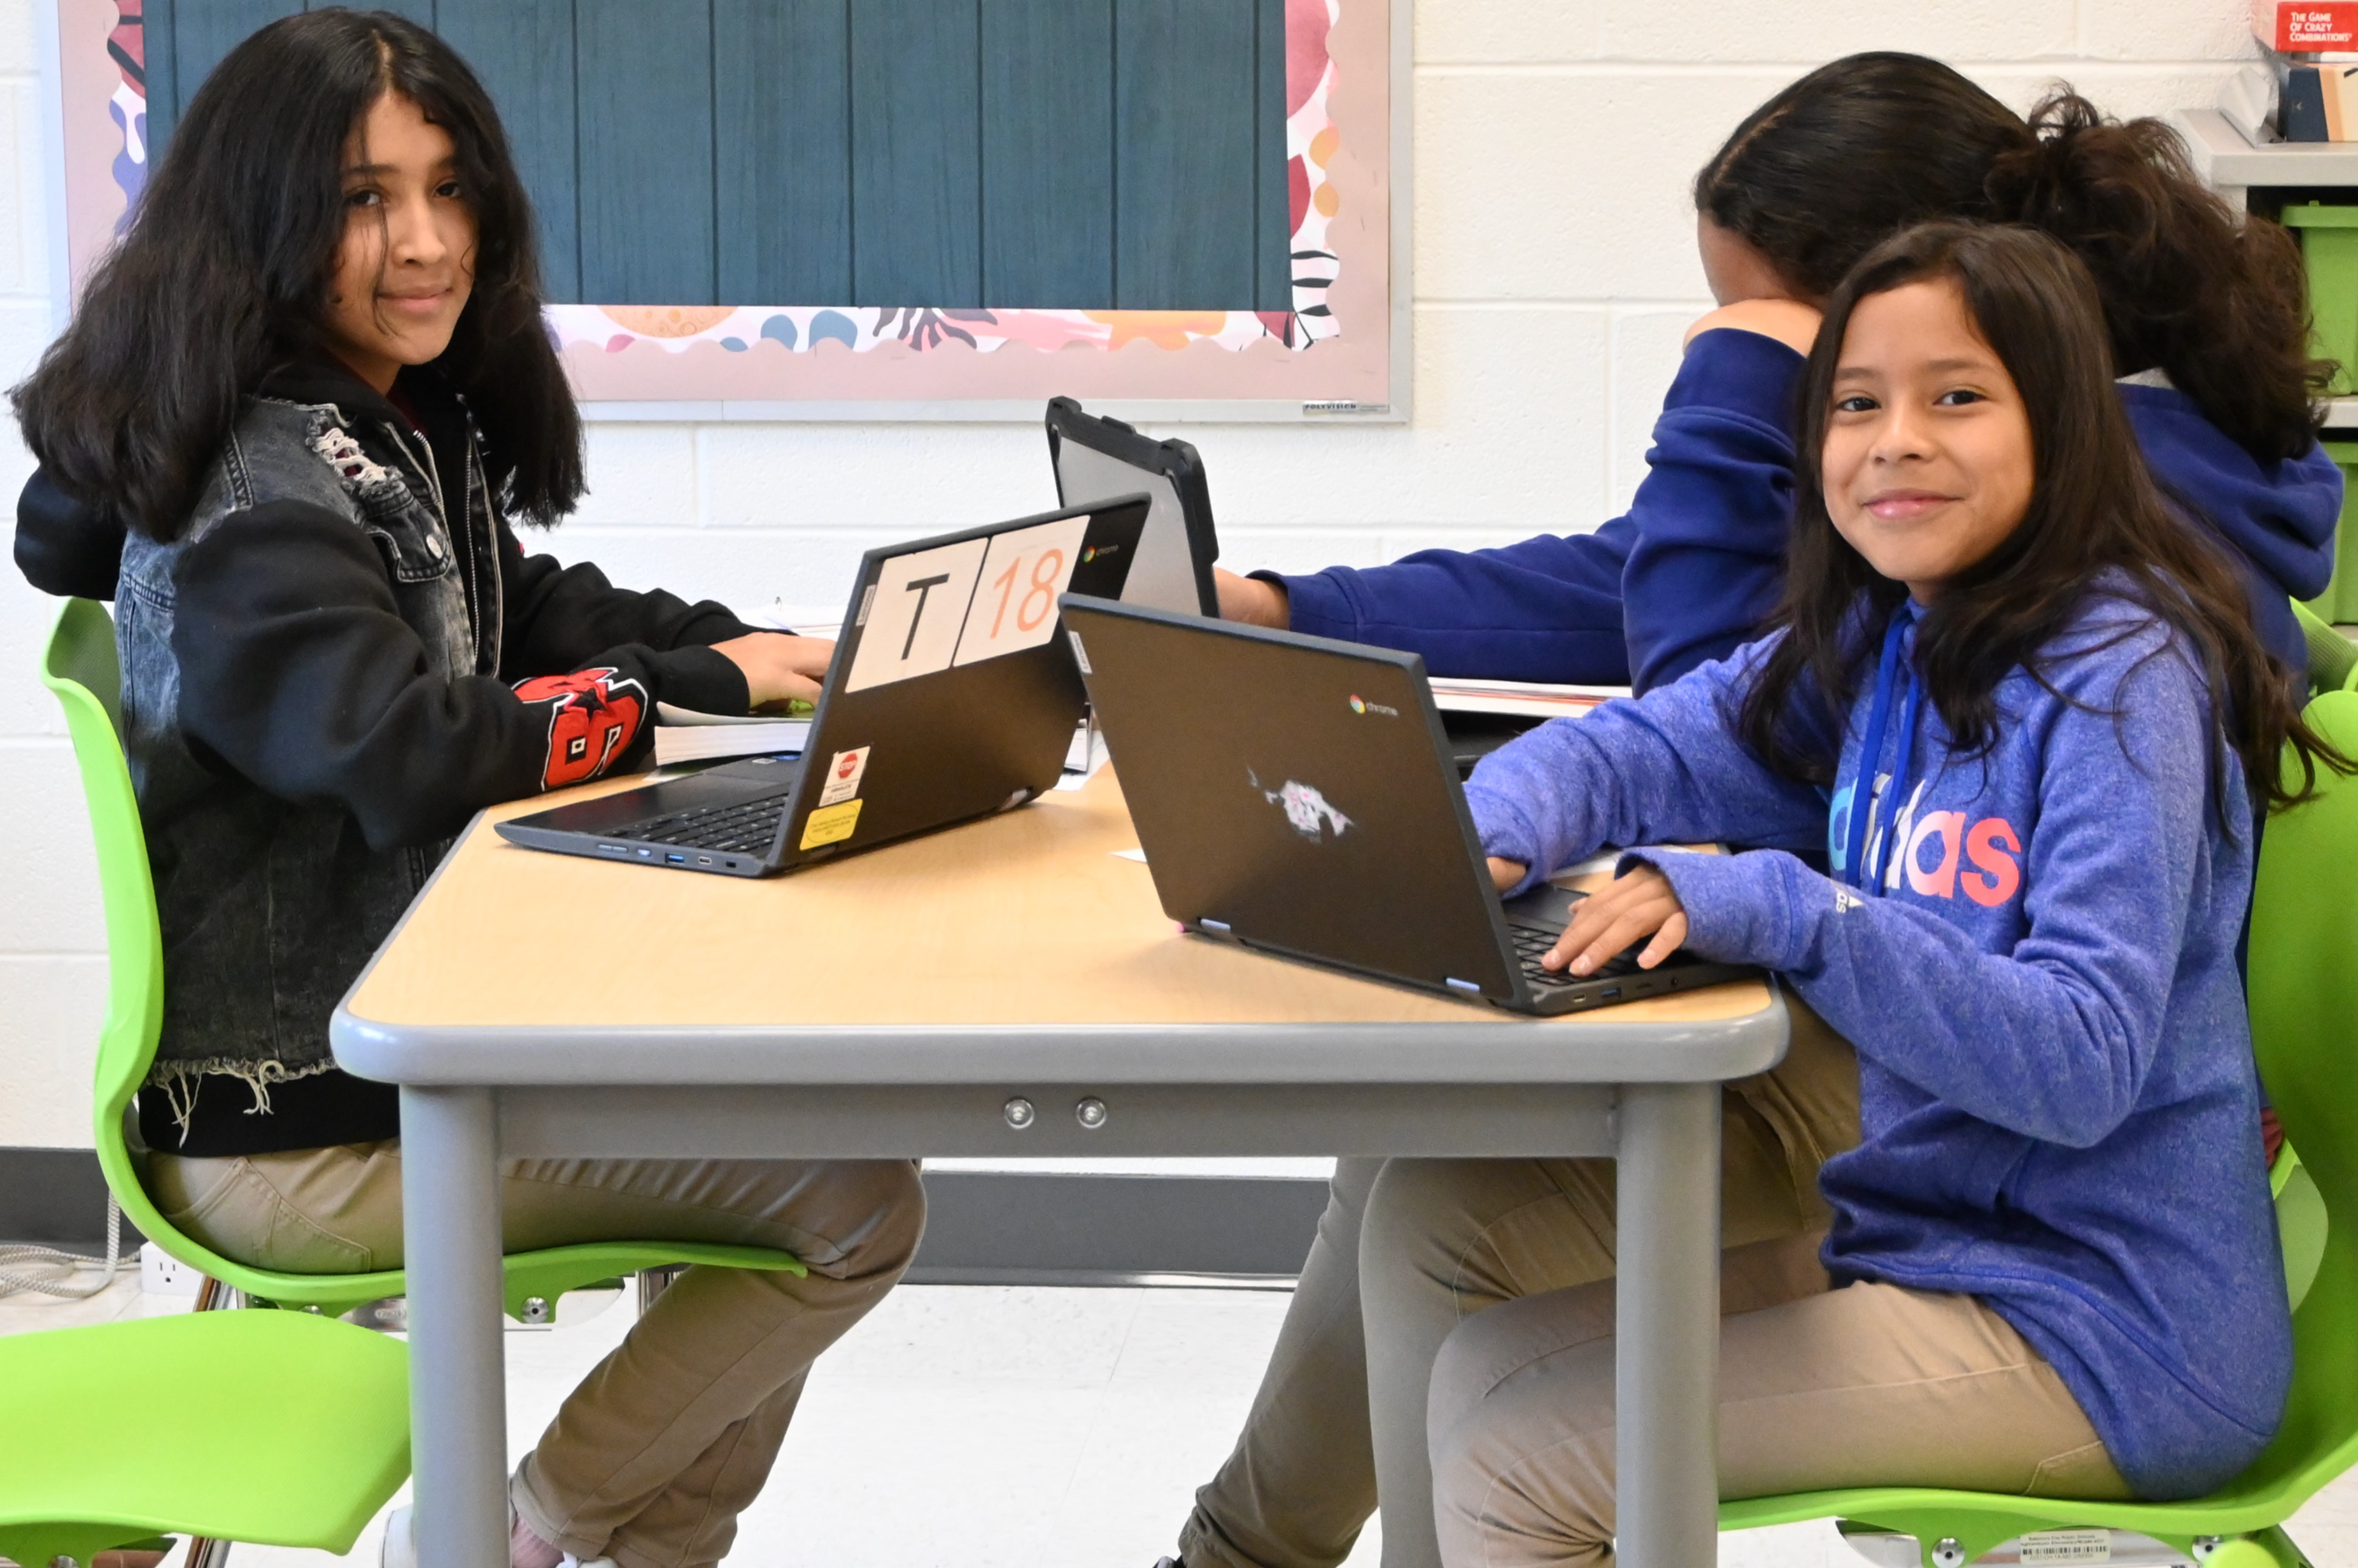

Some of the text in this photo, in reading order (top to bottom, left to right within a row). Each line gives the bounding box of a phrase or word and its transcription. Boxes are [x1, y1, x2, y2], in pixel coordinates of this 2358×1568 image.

[2291, 11, 2331, 22] THE GAME
[2289, 22, 2333, 32] OF CRAZY
[989, 549, 1063, 639] 18
[901, 573, 950, 661] T
[1366, 701, 1398, 716] chrome
[839, 760, 858, 772] STOP
